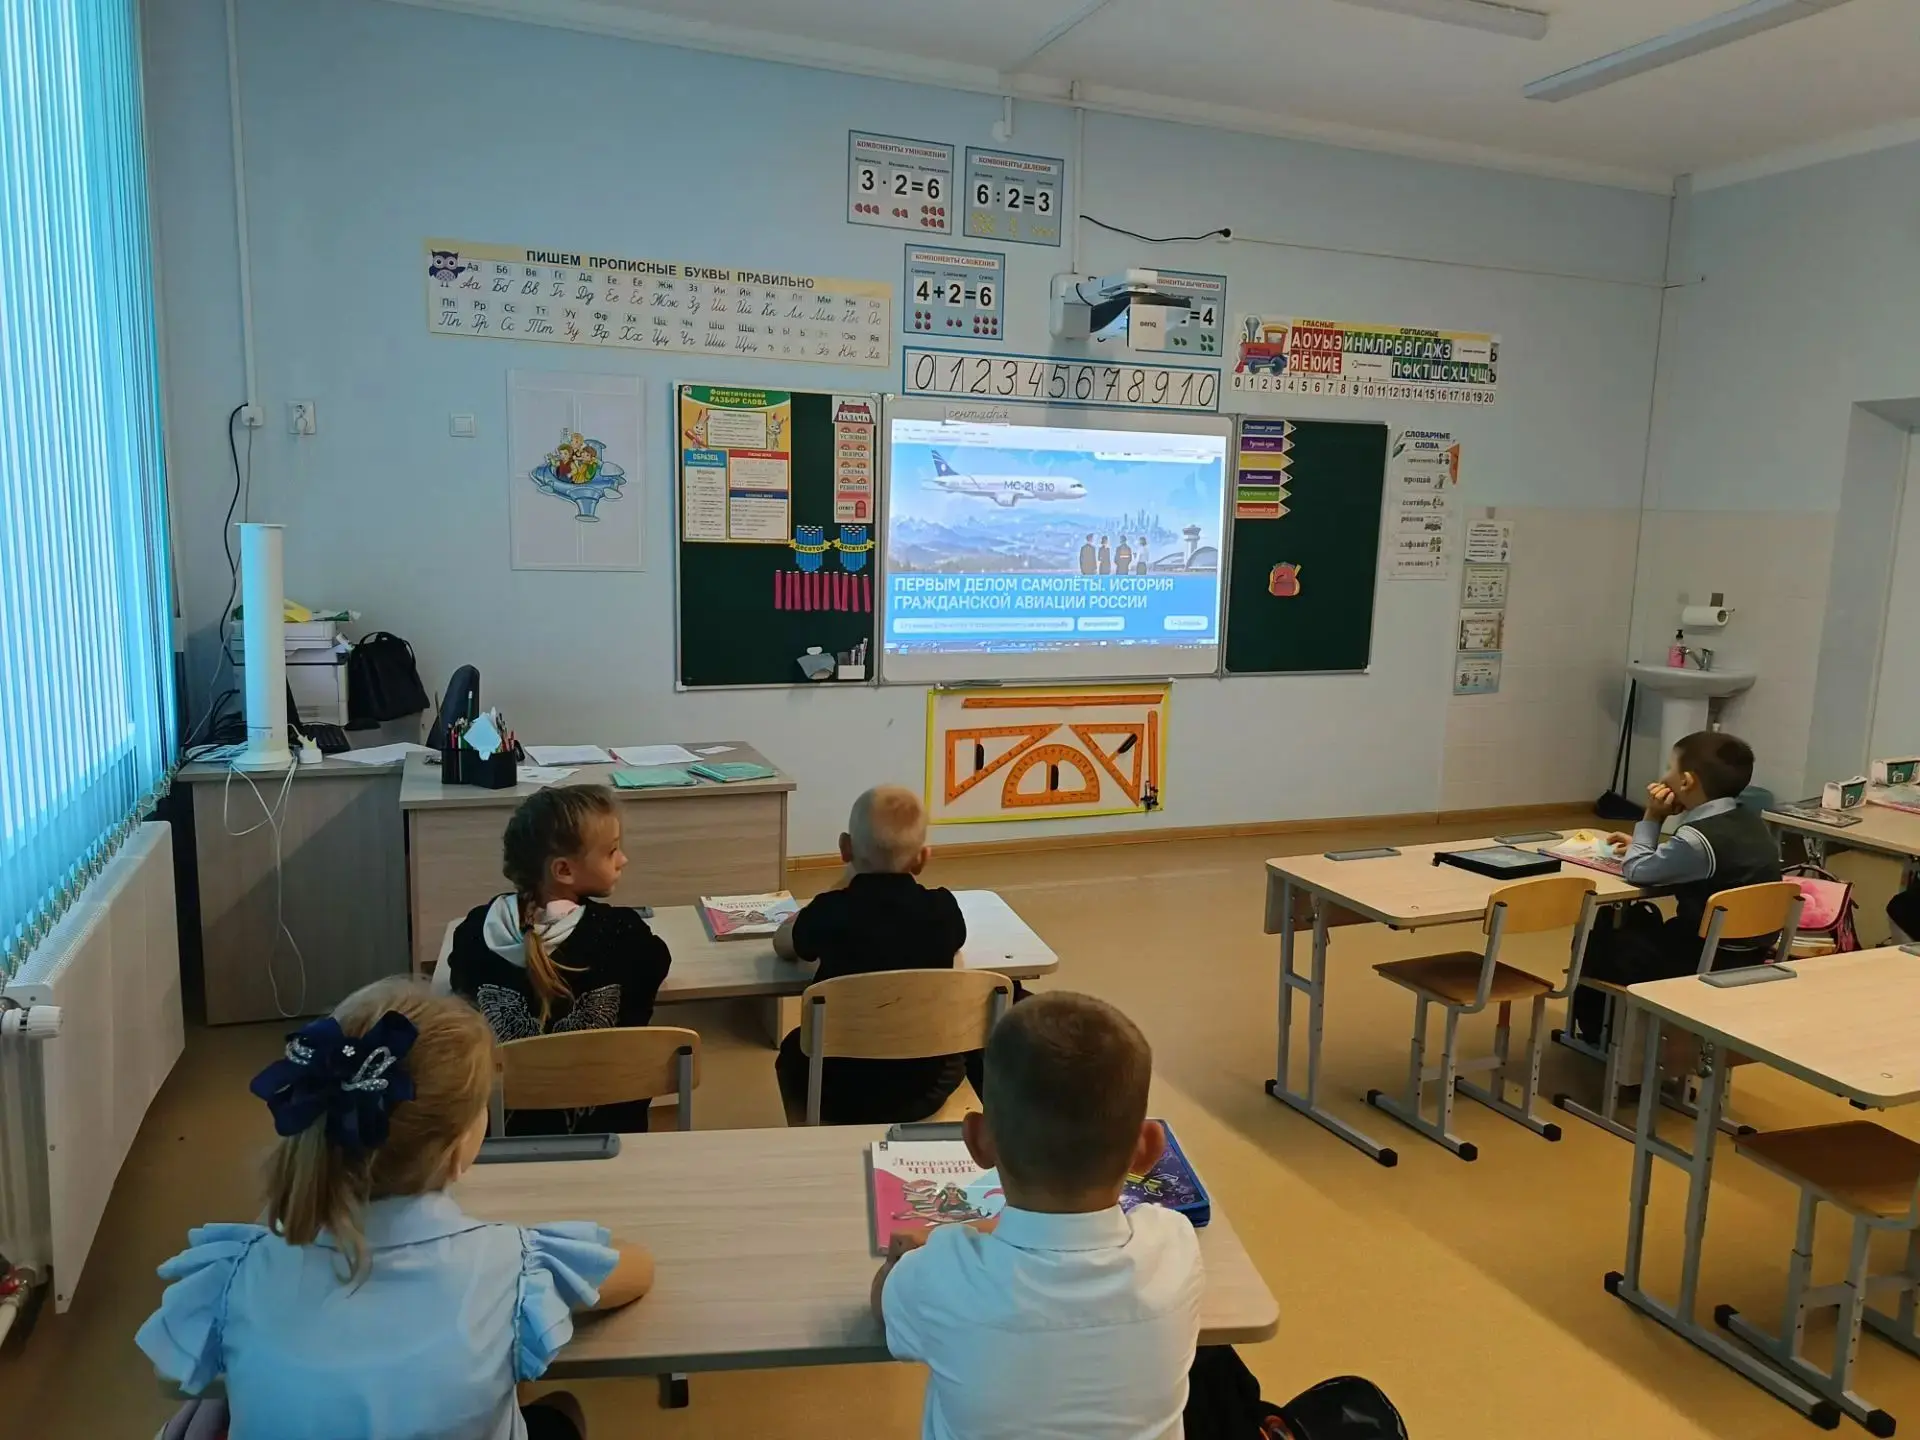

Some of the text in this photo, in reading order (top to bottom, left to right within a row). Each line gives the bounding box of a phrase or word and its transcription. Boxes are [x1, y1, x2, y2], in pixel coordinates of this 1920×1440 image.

[526, 249, 815, 289] ПИШЕМ ПРОПИСНЫЕ БУКВЫ ПРАВИЛЬНО
[1302, 320, 1439, 338] ГЛАСНЫЕ СОГЛАСНЫЕ
[915, 354, 1215, 406] 0 1 2 3 4 5 6 7 8 9 10
[1235, 376, 1495, 404] 0 1 2 3 4 5 6 7 8 9 10 11 12 13 14 15 16 17 18 19 20
[710, 396, 768, 406] РАЗБОР СЛОВА
[1405, 430, 1451, 440] СЛОВАРНЫЕ
[1415, 441, 1440, 449] СЛОВА
[895, 575, 1174, 594] ПЕРВЫМ ДЕЛОМ САМОЛЁТЫ. ИСТОРИЯ
[894, 592, 1148, 612] ГРАЖДАНСКОЙ АВИАЦИИ РОССИИ
[909, 1165, 977, 1175] ЧТЕНИЕ
